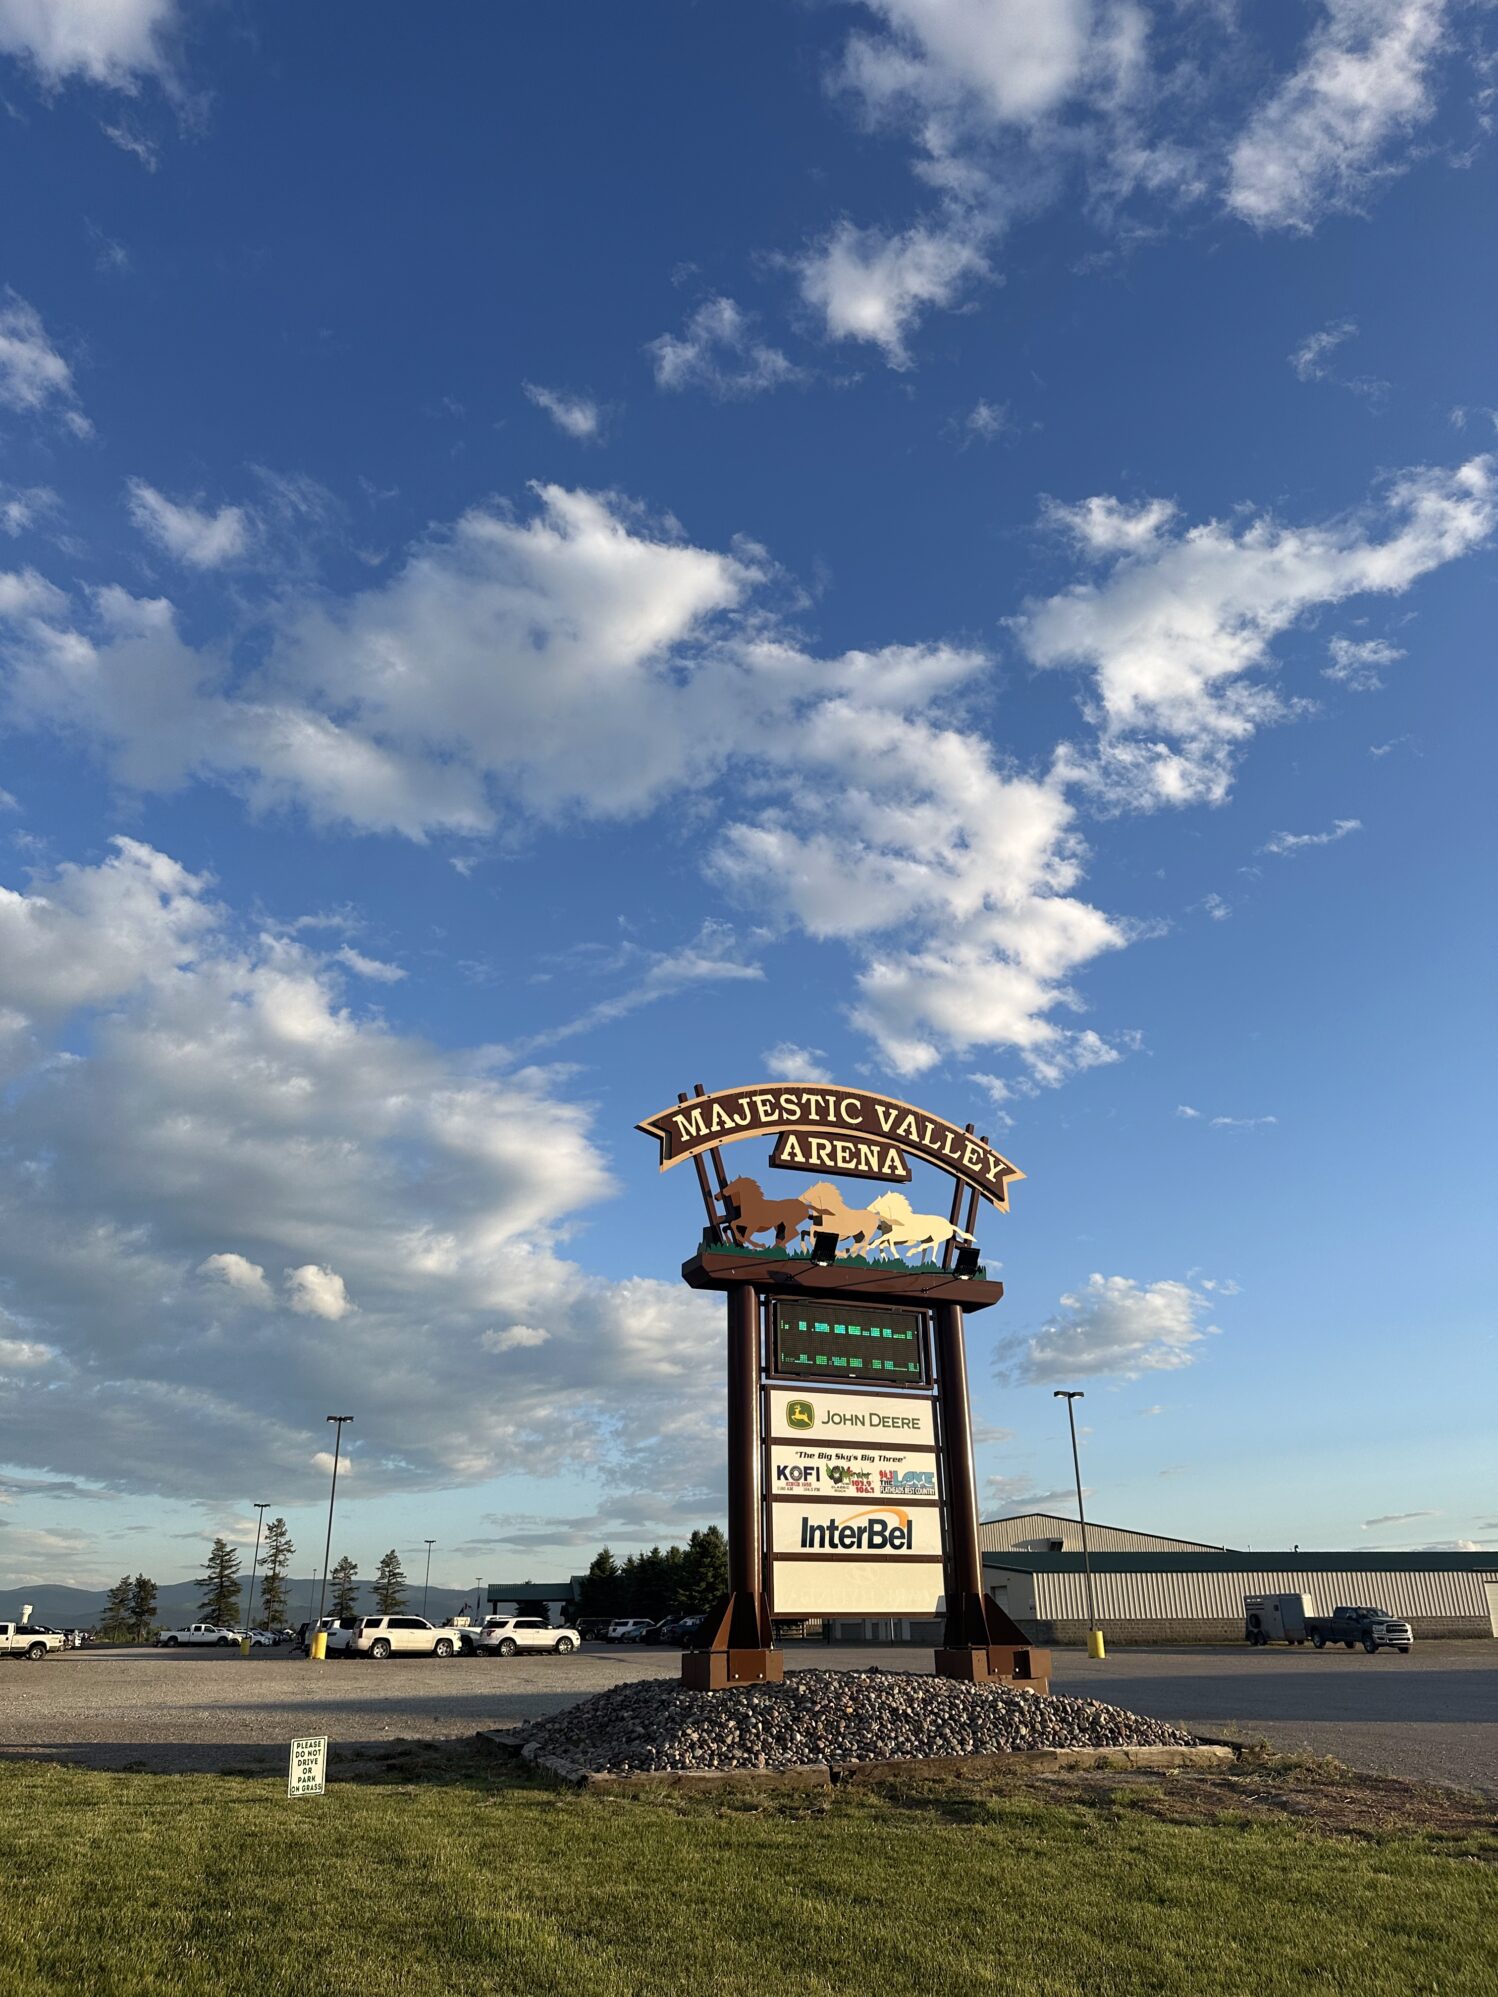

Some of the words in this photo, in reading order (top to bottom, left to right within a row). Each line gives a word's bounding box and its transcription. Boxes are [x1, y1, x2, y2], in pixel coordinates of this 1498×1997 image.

[672, 1093, 864, 1142] MAJESTIC
[875, 1104, 1008, 1183] VALLEY
[780, 1134, 907, 1176] ARENA
[821, 1410, 866, 1427] JOHN
[869, 1412, 921, 1430] DEERE
[817, 1452, 833, 1461] Big
[835, 1452, 858, 1463] Sky's
[860, 1454, 875, 1463] Big
[776, 1465, 821, 1482] KOFI
[800, 1516, 913, 1550] InterBel
[296, 1740, 322, 1749] PLEASE
[295, 1750, 306, 1758] DO
[307, 1749, 321, 1757] NOT
[297, 1758, 319, 1767] DRIVE
[302, 1767, 313, 1775] OR
[297, 1775, 316, 1784] PARK
[291, 1785, 300, 1793] ON
[301, 1784, 322, 1792] GRASS
